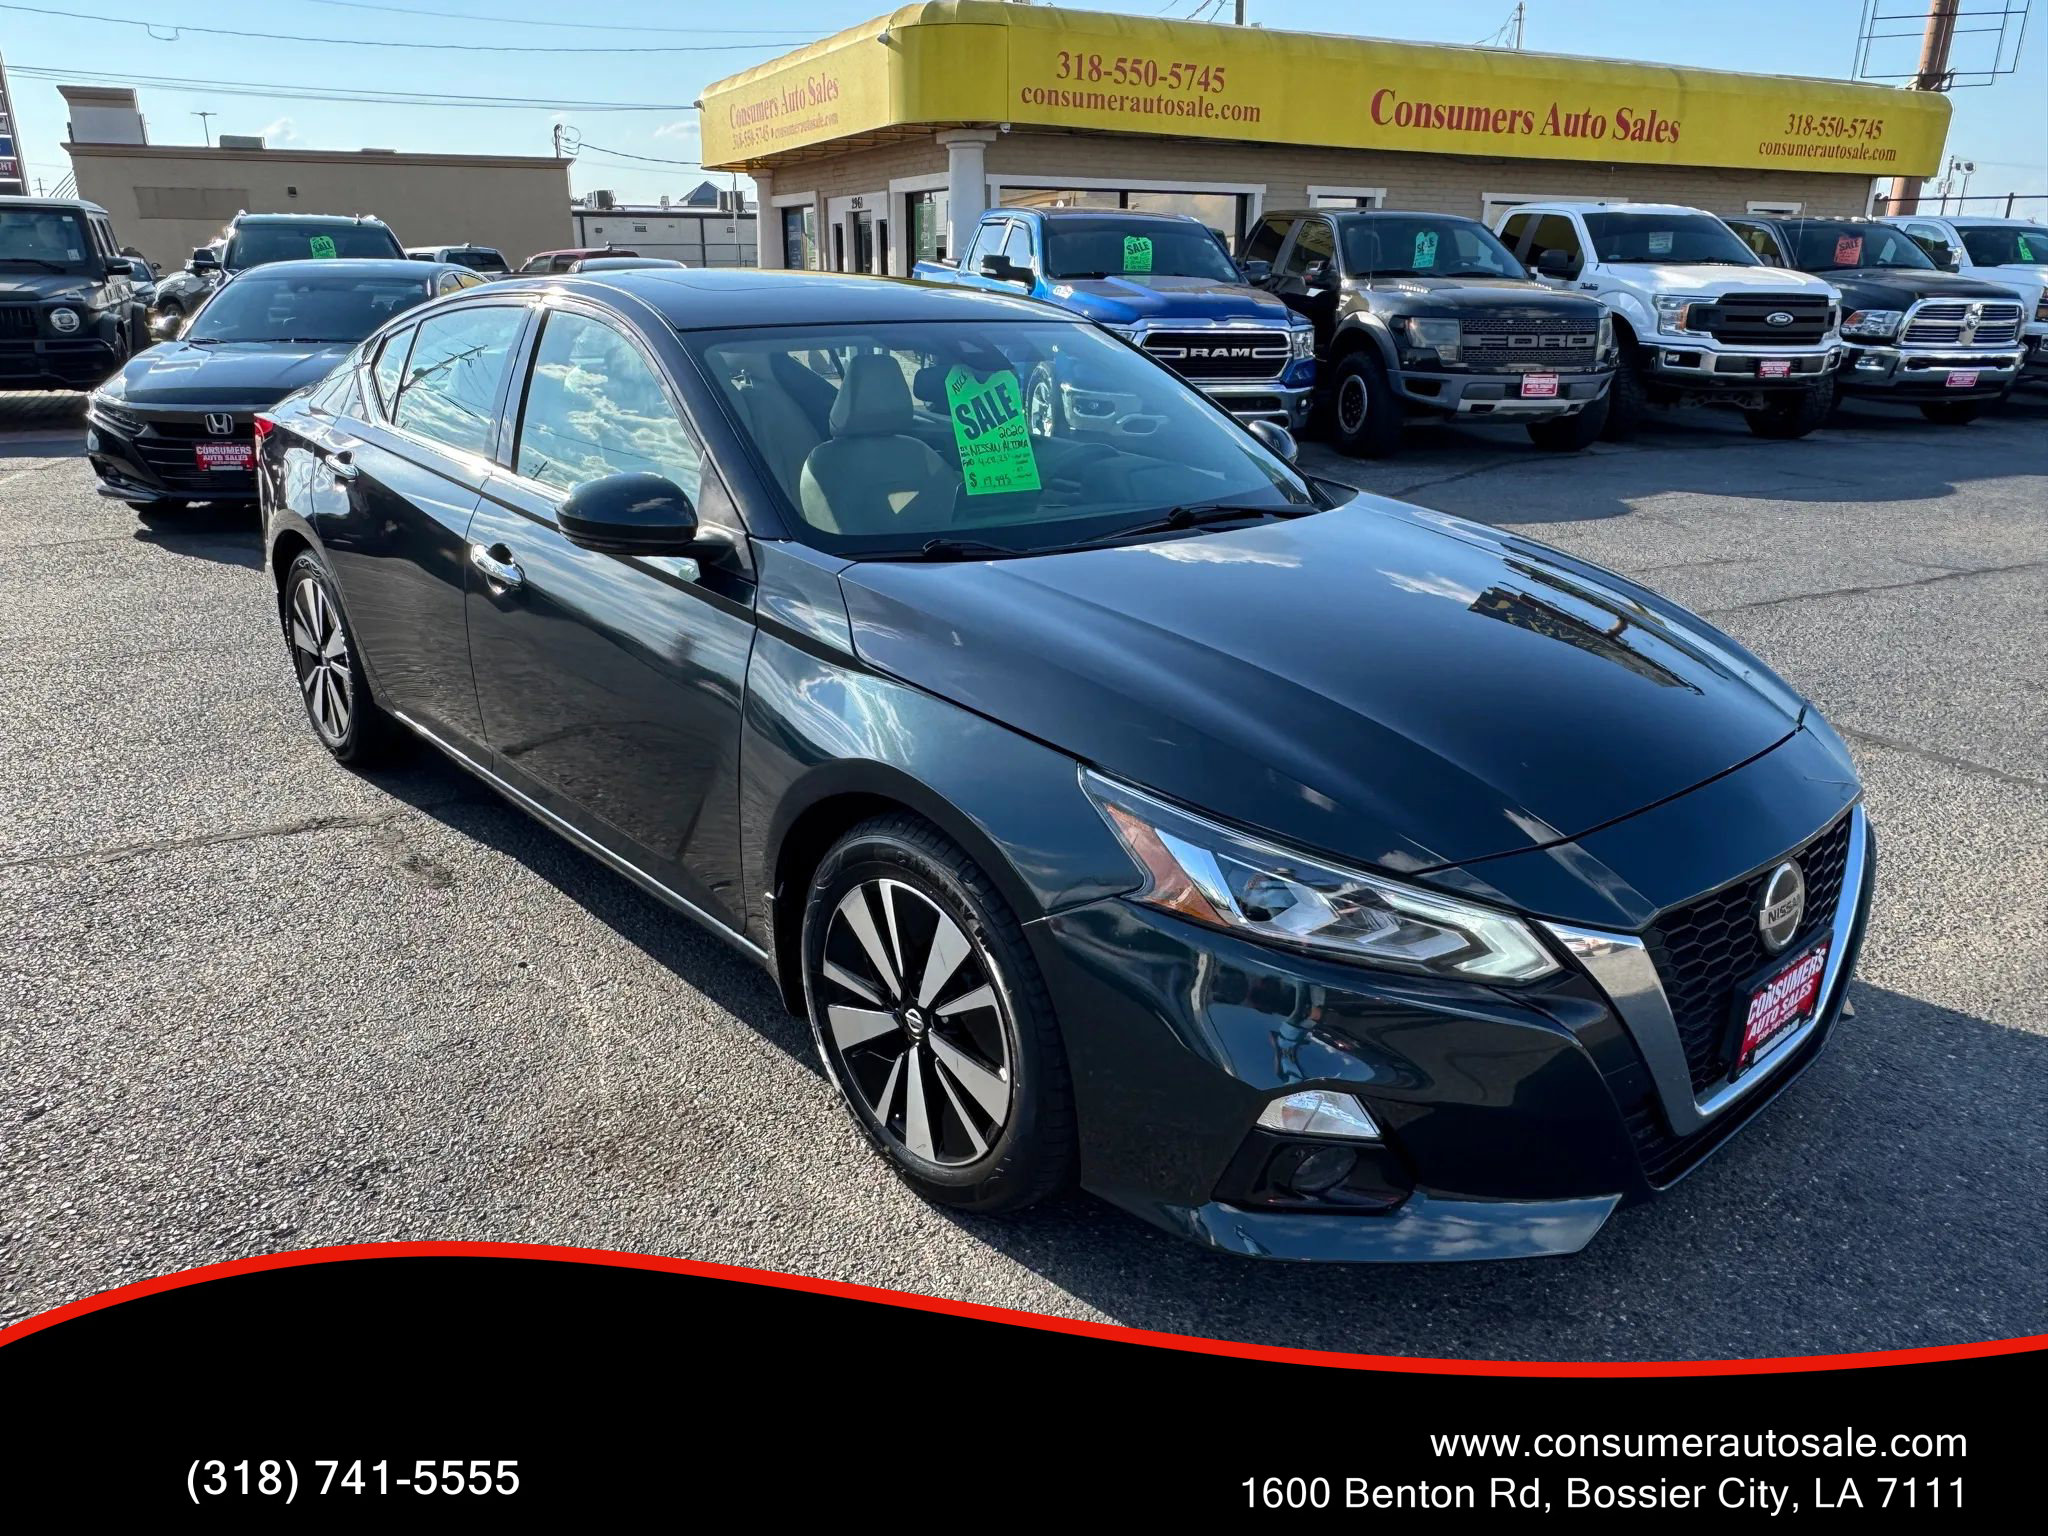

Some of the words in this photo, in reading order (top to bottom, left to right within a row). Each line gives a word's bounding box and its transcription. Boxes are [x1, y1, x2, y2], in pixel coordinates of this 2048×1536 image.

[1056, 51, 1225, 93] 318-550-5745
[729, 96, 779, 129] Consumers
[780, 83, 806, 116] Auto
[807, 72, 839, 106] Sales
[1021, 86, 1261, 123] consumerautosale.com
[1370, 88, 1535, 136] Consumers
[1539, 102, 1607, 139] Auto
[1612, 107, 1681, 144] Sales
[1784, 113, 1884, 140] 318-550-5745
[1759, 141, 1897, 161] consumerautosale.com
[1126, 241, 1150, 255] SALE
[1190, 347, 1250, 358] RAM
[1471, 334, 1596, 348] FORD
[955, 382, 1019, 440] SALE
[1746, 954, 1825, 1025] CONSUMERS
[1747, 1005, 1780, 1041] AUTO
[1780, 979, 1814, 1015] SALES
